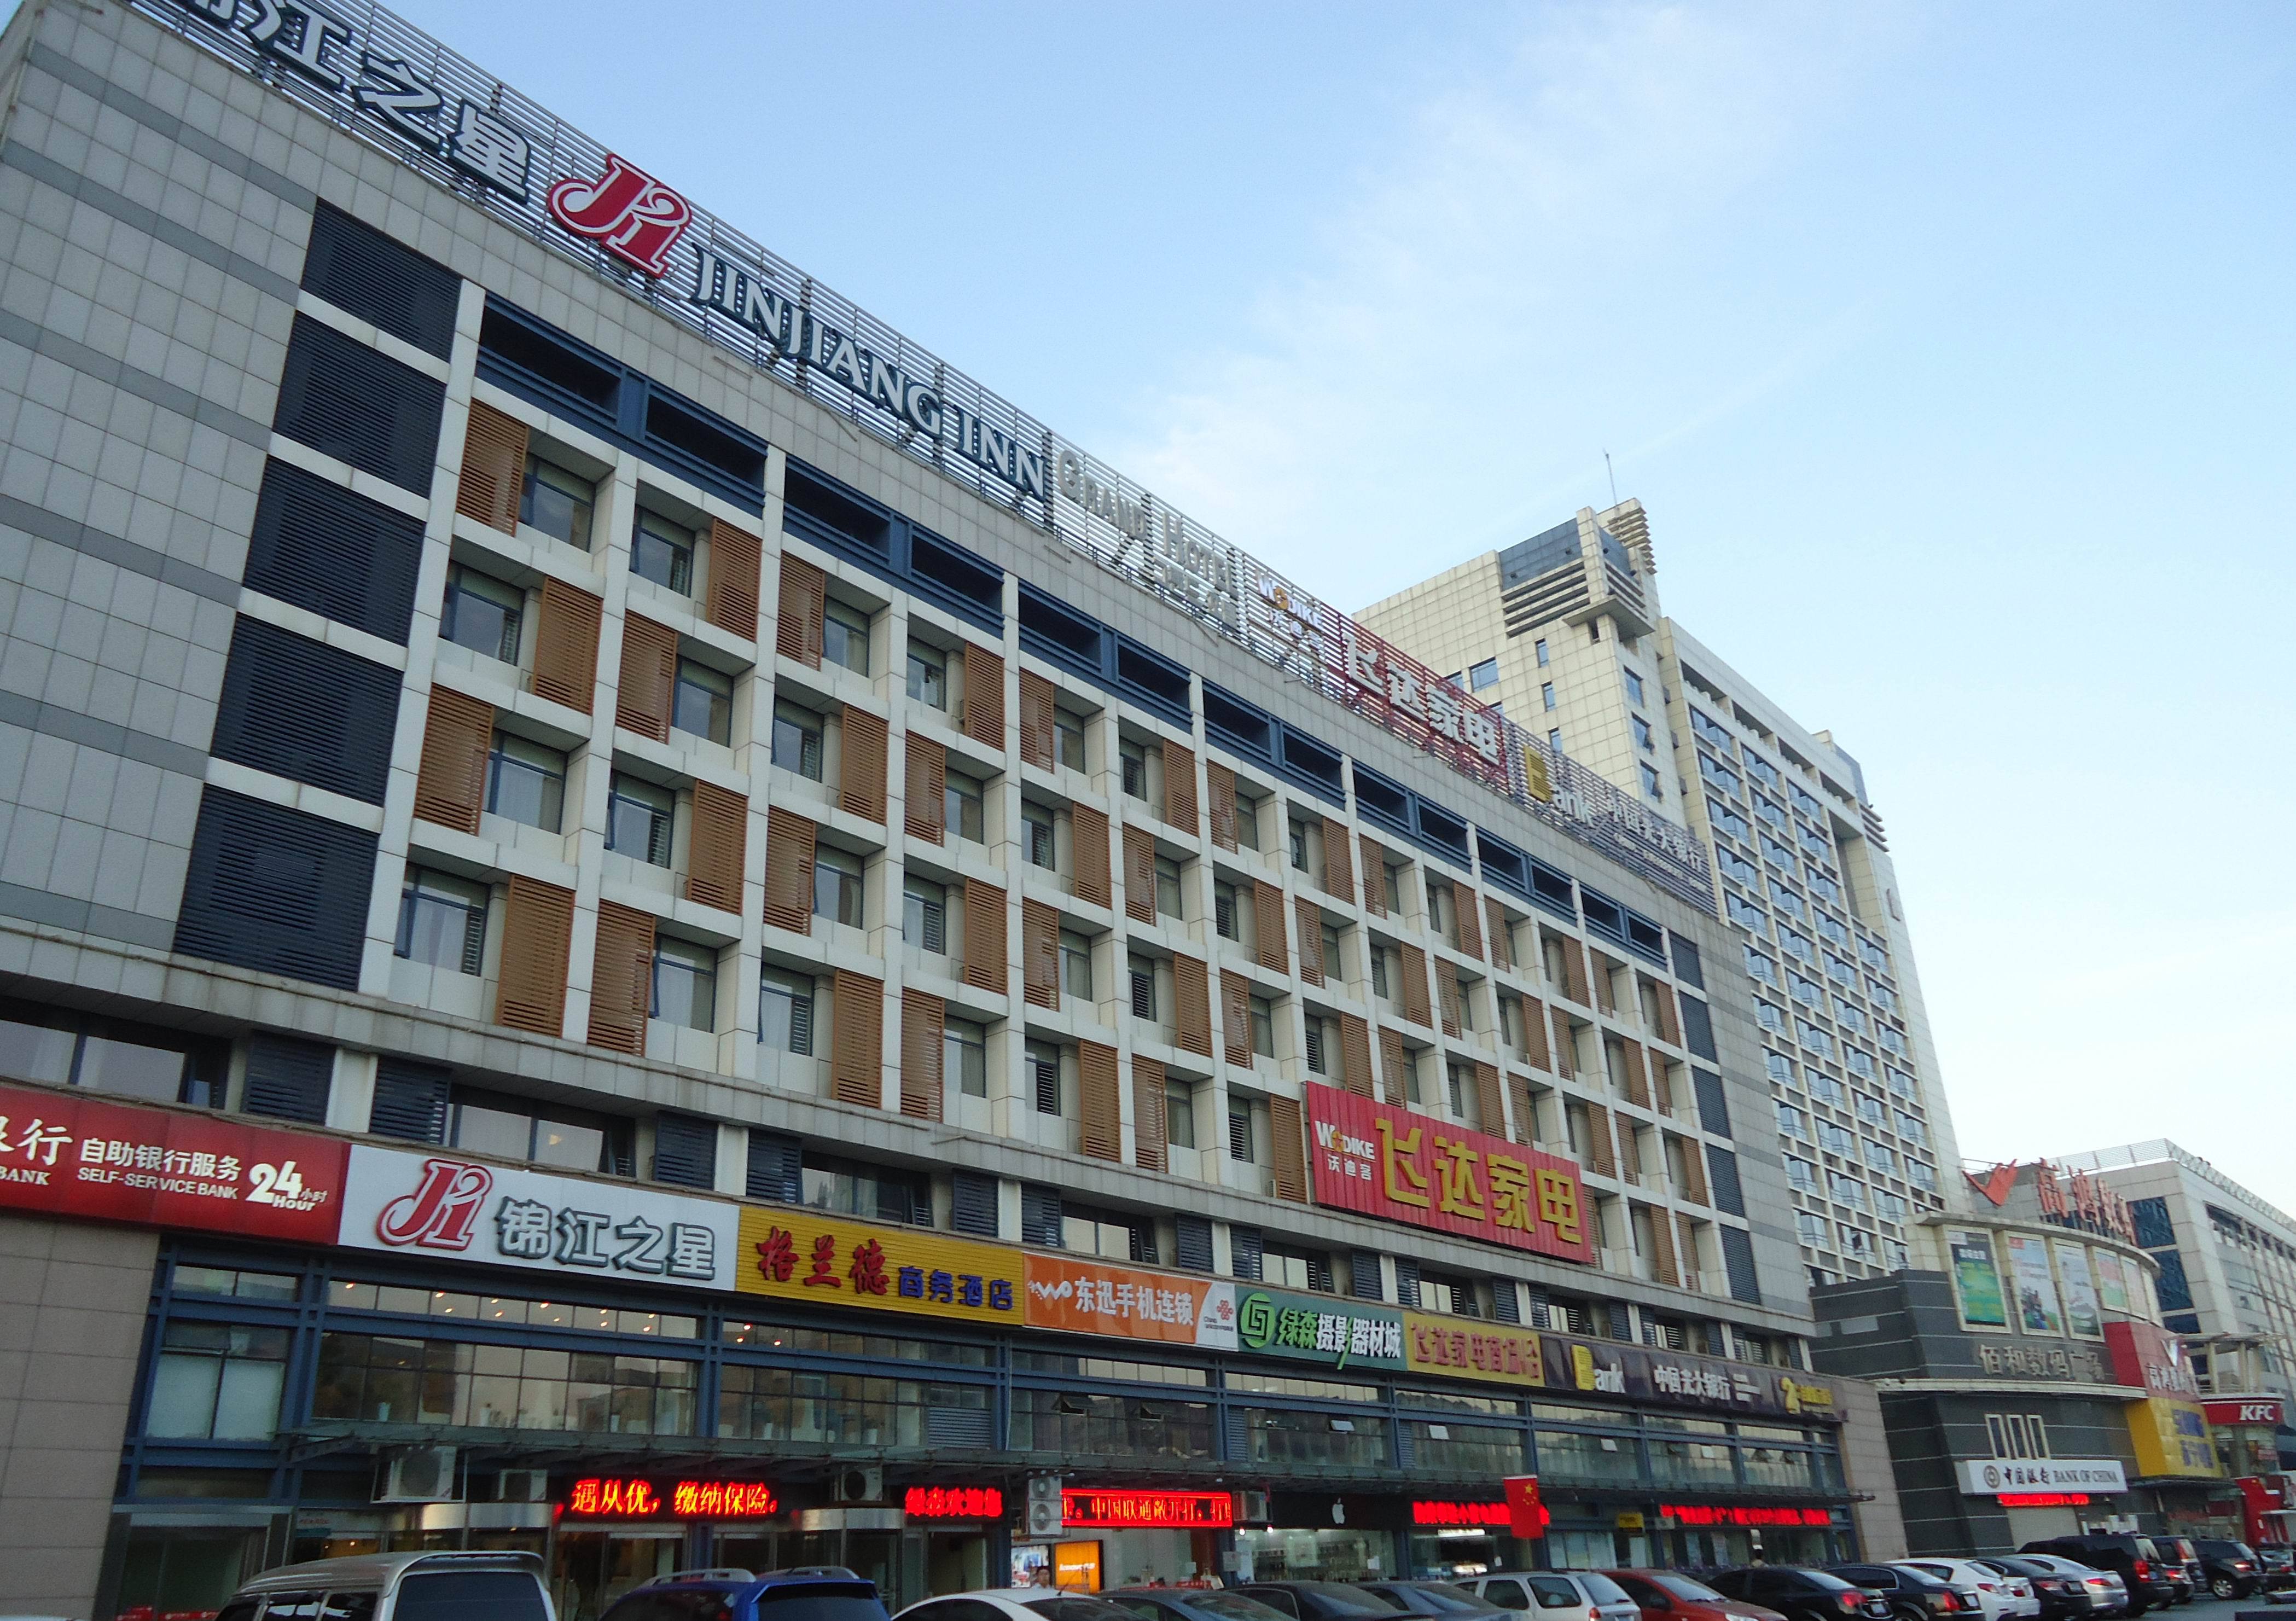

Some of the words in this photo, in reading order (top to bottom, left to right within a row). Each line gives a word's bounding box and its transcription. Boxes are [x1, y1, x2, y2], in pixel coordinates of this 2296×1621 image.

[690, 242, 943, 439] JINJIANG
[952, 404, 1047, 503] INN
[1056, 450, 1148, 541] GRAND
[1162, 511, 1239, 600] HOTEL
[1342, 631, 1502, 766] 飞达家电
[80, 1137, 242, 1182] 自助银行服务
[1315, 1120, 1375, 1160] WODIKE
[0, 1165, 51, 1186] BANK
[78, 1167, 196, 1195] SELF-SERVICE
[197, 1183, 240, 1200] BANK
[246, 1160, 303, 1204] 24
[1327, 1154, 1372, 1181] 沃迪客
[1375, 1118, 1583, 1245] 飞达家电
[300, 1187, 328, 1203] 小时
[495, 1195, 716, 1281] 锦江之星
[755, 1225, 891, 1296] 格兰德
[898, 1265, 1014, 1311] 商务酒店
[1074, 1276, 1195, 1326] 东迅手机连锁
[1571, 1344, 1626, 1394] Bank
[1653, 1364, 1731, 1401] 中国光大银行
[2239, 1405, 2275, 1421] KFC
[2003, 1466, 2050, 1485] 中国银行
[2053, 1469, 2078, 1483] BANK
[2080, 1469, 2091, 1483] OF
[2092, 1470, 2119, 1483] CHINA
